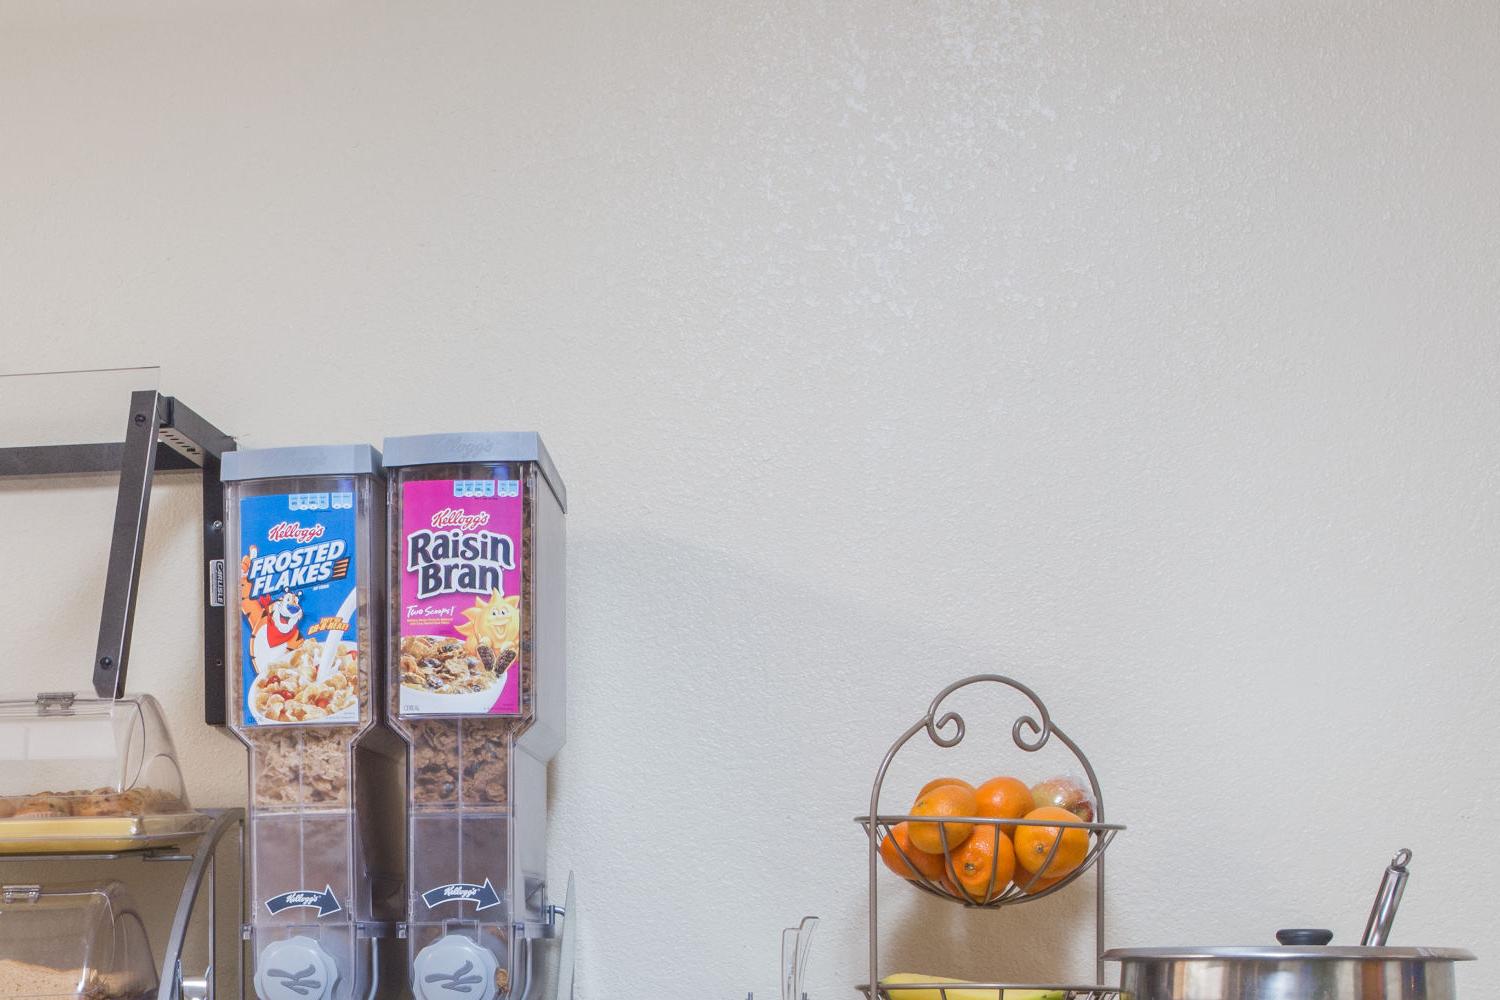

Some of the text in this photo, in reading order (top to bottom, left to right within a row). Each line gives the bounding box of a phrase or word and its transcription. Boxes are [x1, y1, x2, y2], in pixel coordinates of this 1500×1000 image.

[432, 509, 489, 529] Kellogg's
[269, 522, 325, 542] Kellogg's
[410, 531, 512, 568] Raisin
[250, 541, 346, 580] FROSTED
[251, 561, 333, 597] FLAKES
[421, 563, 500, 596] Bran
[406, 606, 454, 617] Two Scoops!
[286, 893, 319, 905] Kellogg's
[444, 886, 477, 898] Kellogg's
